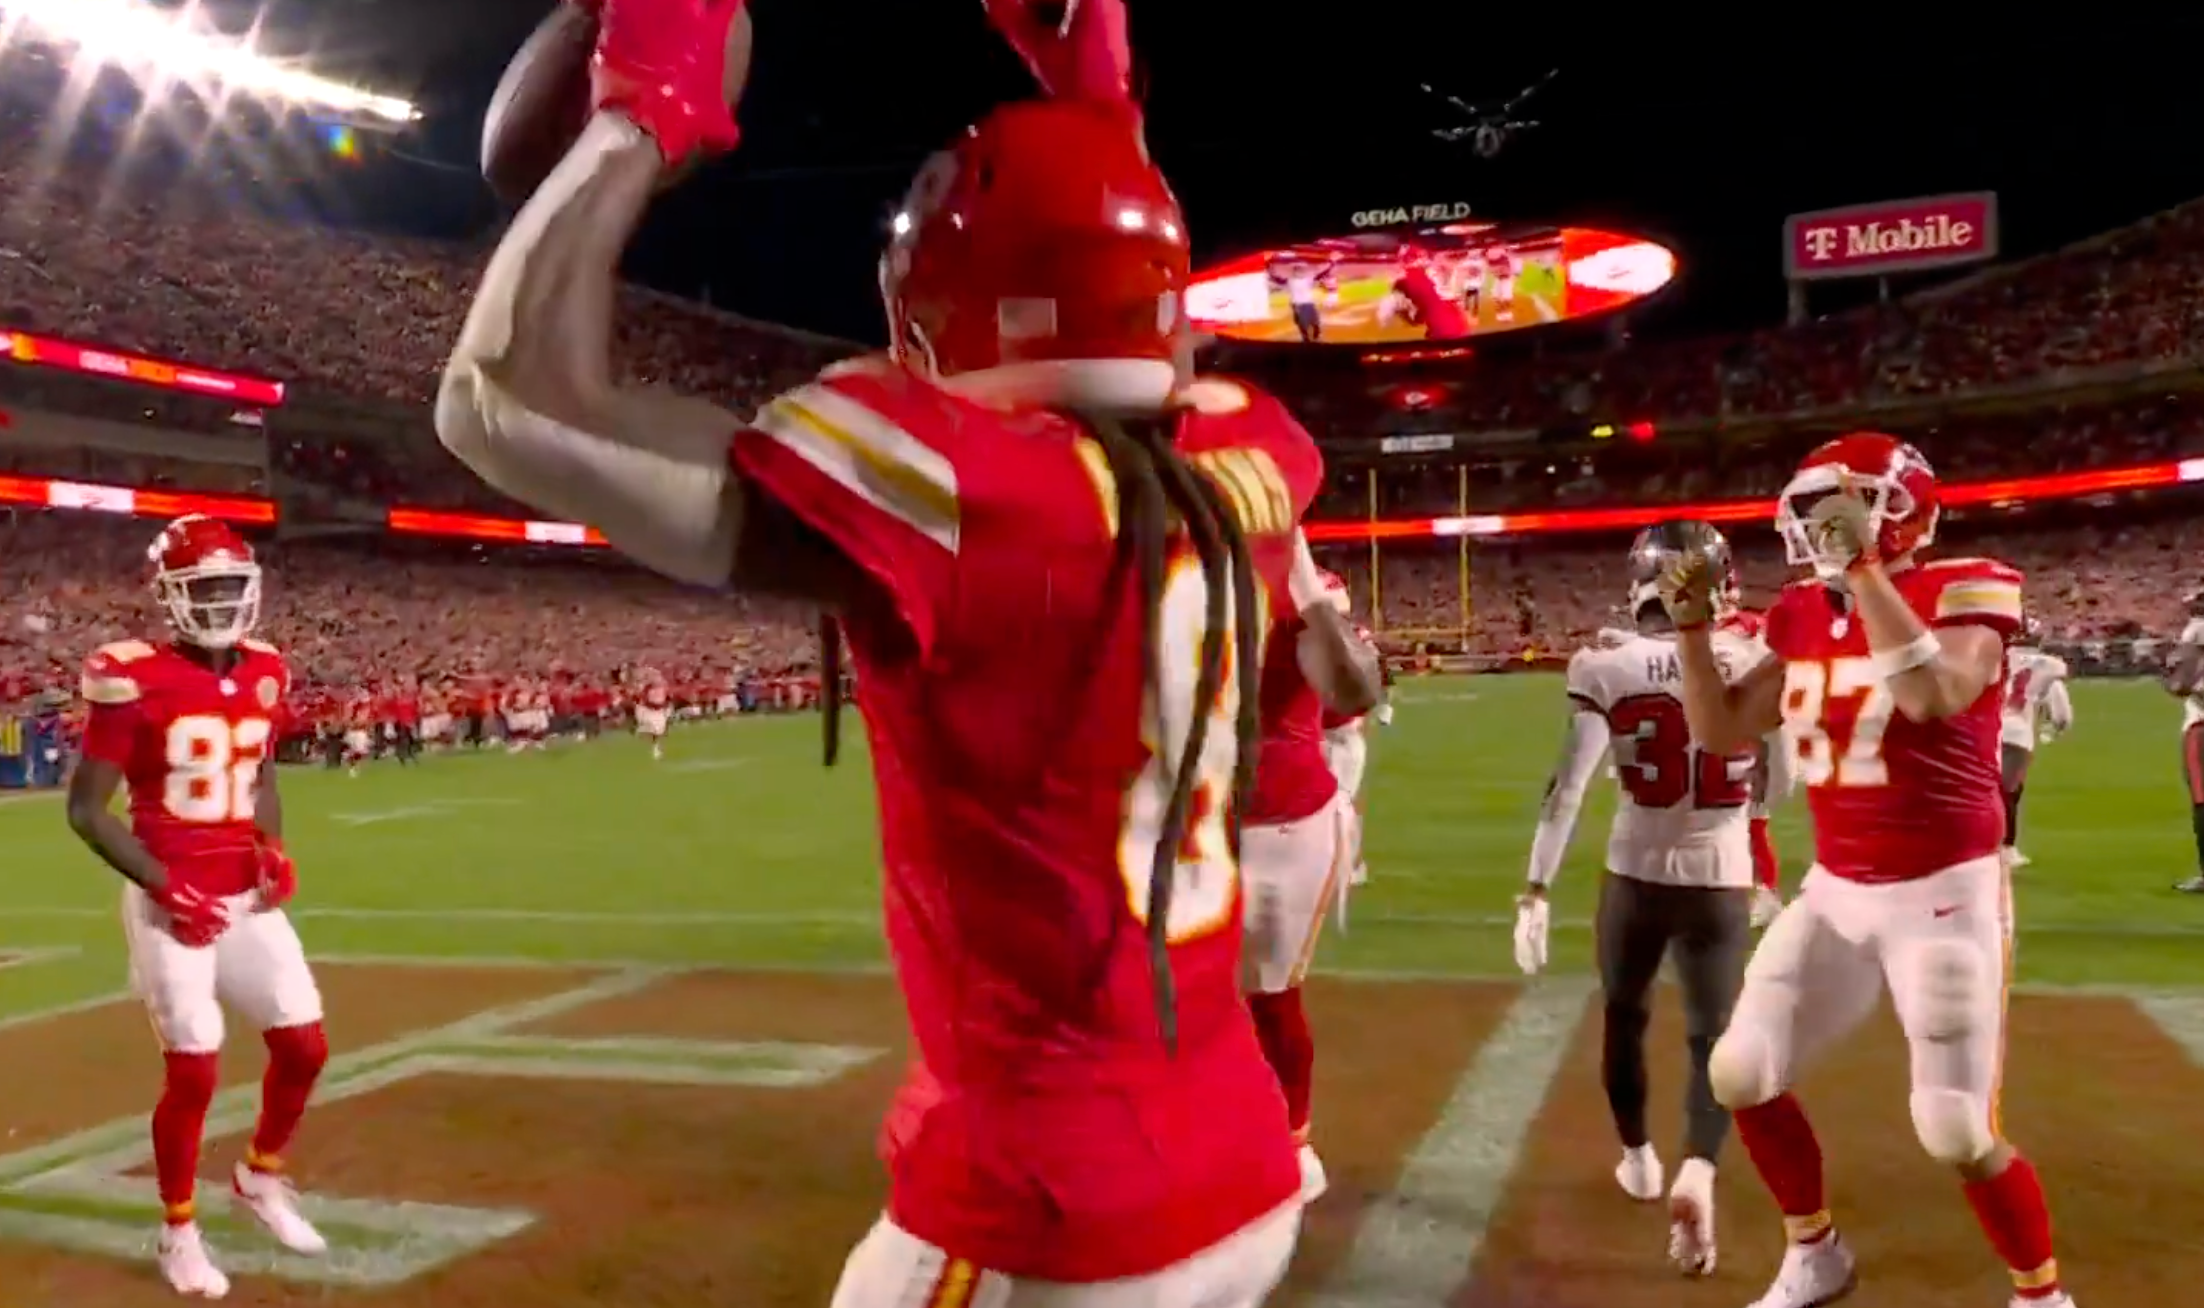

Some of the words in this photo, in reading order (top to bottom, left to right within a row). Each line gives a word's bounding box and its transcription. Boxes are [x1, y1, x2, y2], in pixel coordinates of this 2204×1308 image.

[1351, 206, 1410, 228] GEHA
[1412, 201, 1471, 222] FIELD
[1845, 214, 1973, 258] Mobile
[1780, 658, 1896, 786] 87
[163, 714, 271, 823] 82
